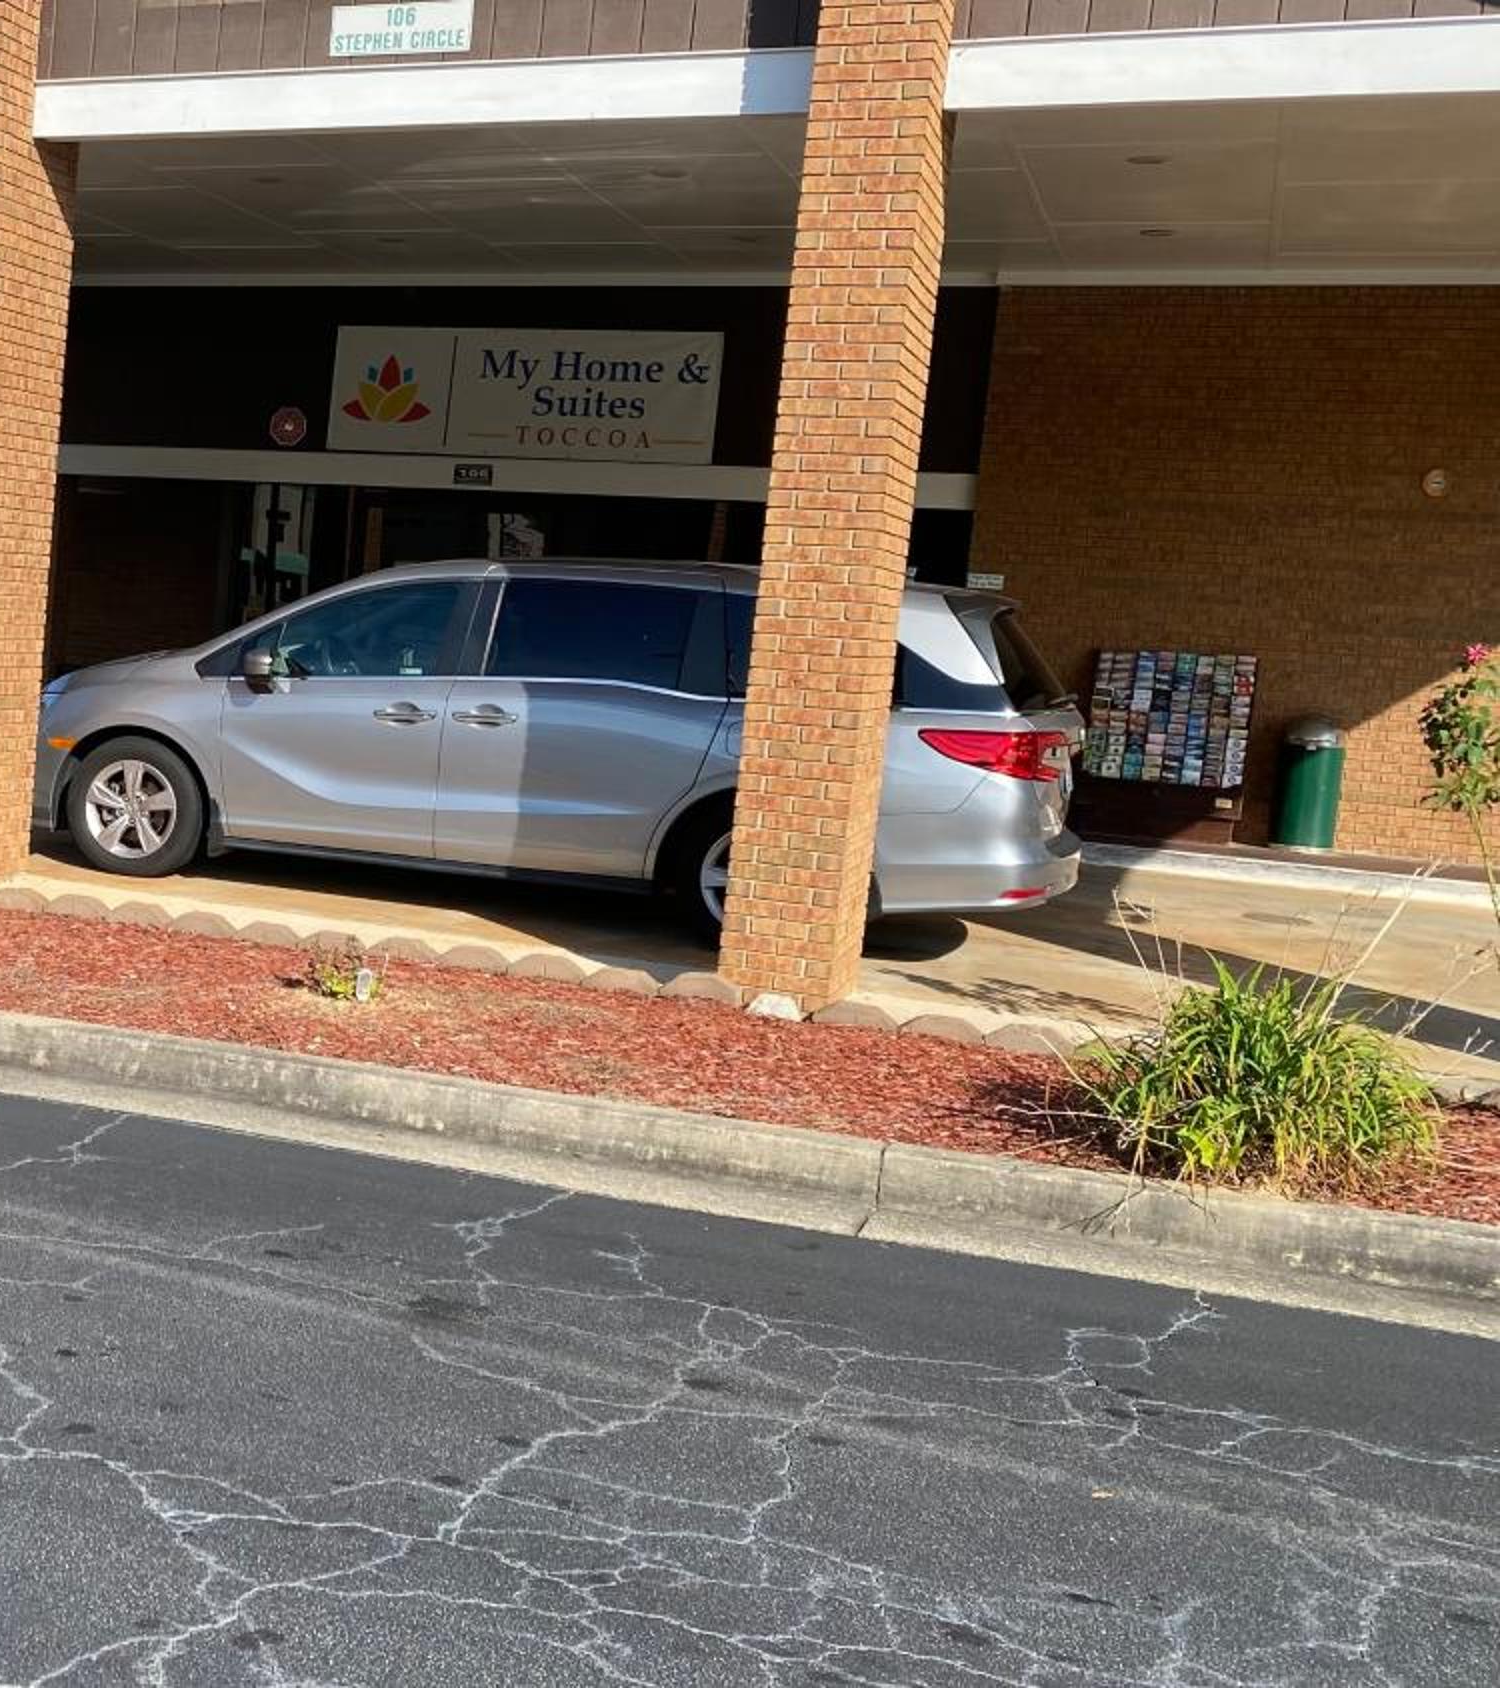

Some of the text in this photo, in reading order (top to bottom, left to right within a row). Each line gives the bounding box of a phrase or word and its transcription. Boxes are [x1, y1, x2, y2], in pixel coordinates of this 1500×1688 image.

[387, 7, 417, 26] 106
[335, 29, 465, 51] STEPHEN CIRCLE
[480, 350, 710, 389] My Home &
[532, 386, 645, 419] Suites
[516, 425, 650, 449] TOCCOA
